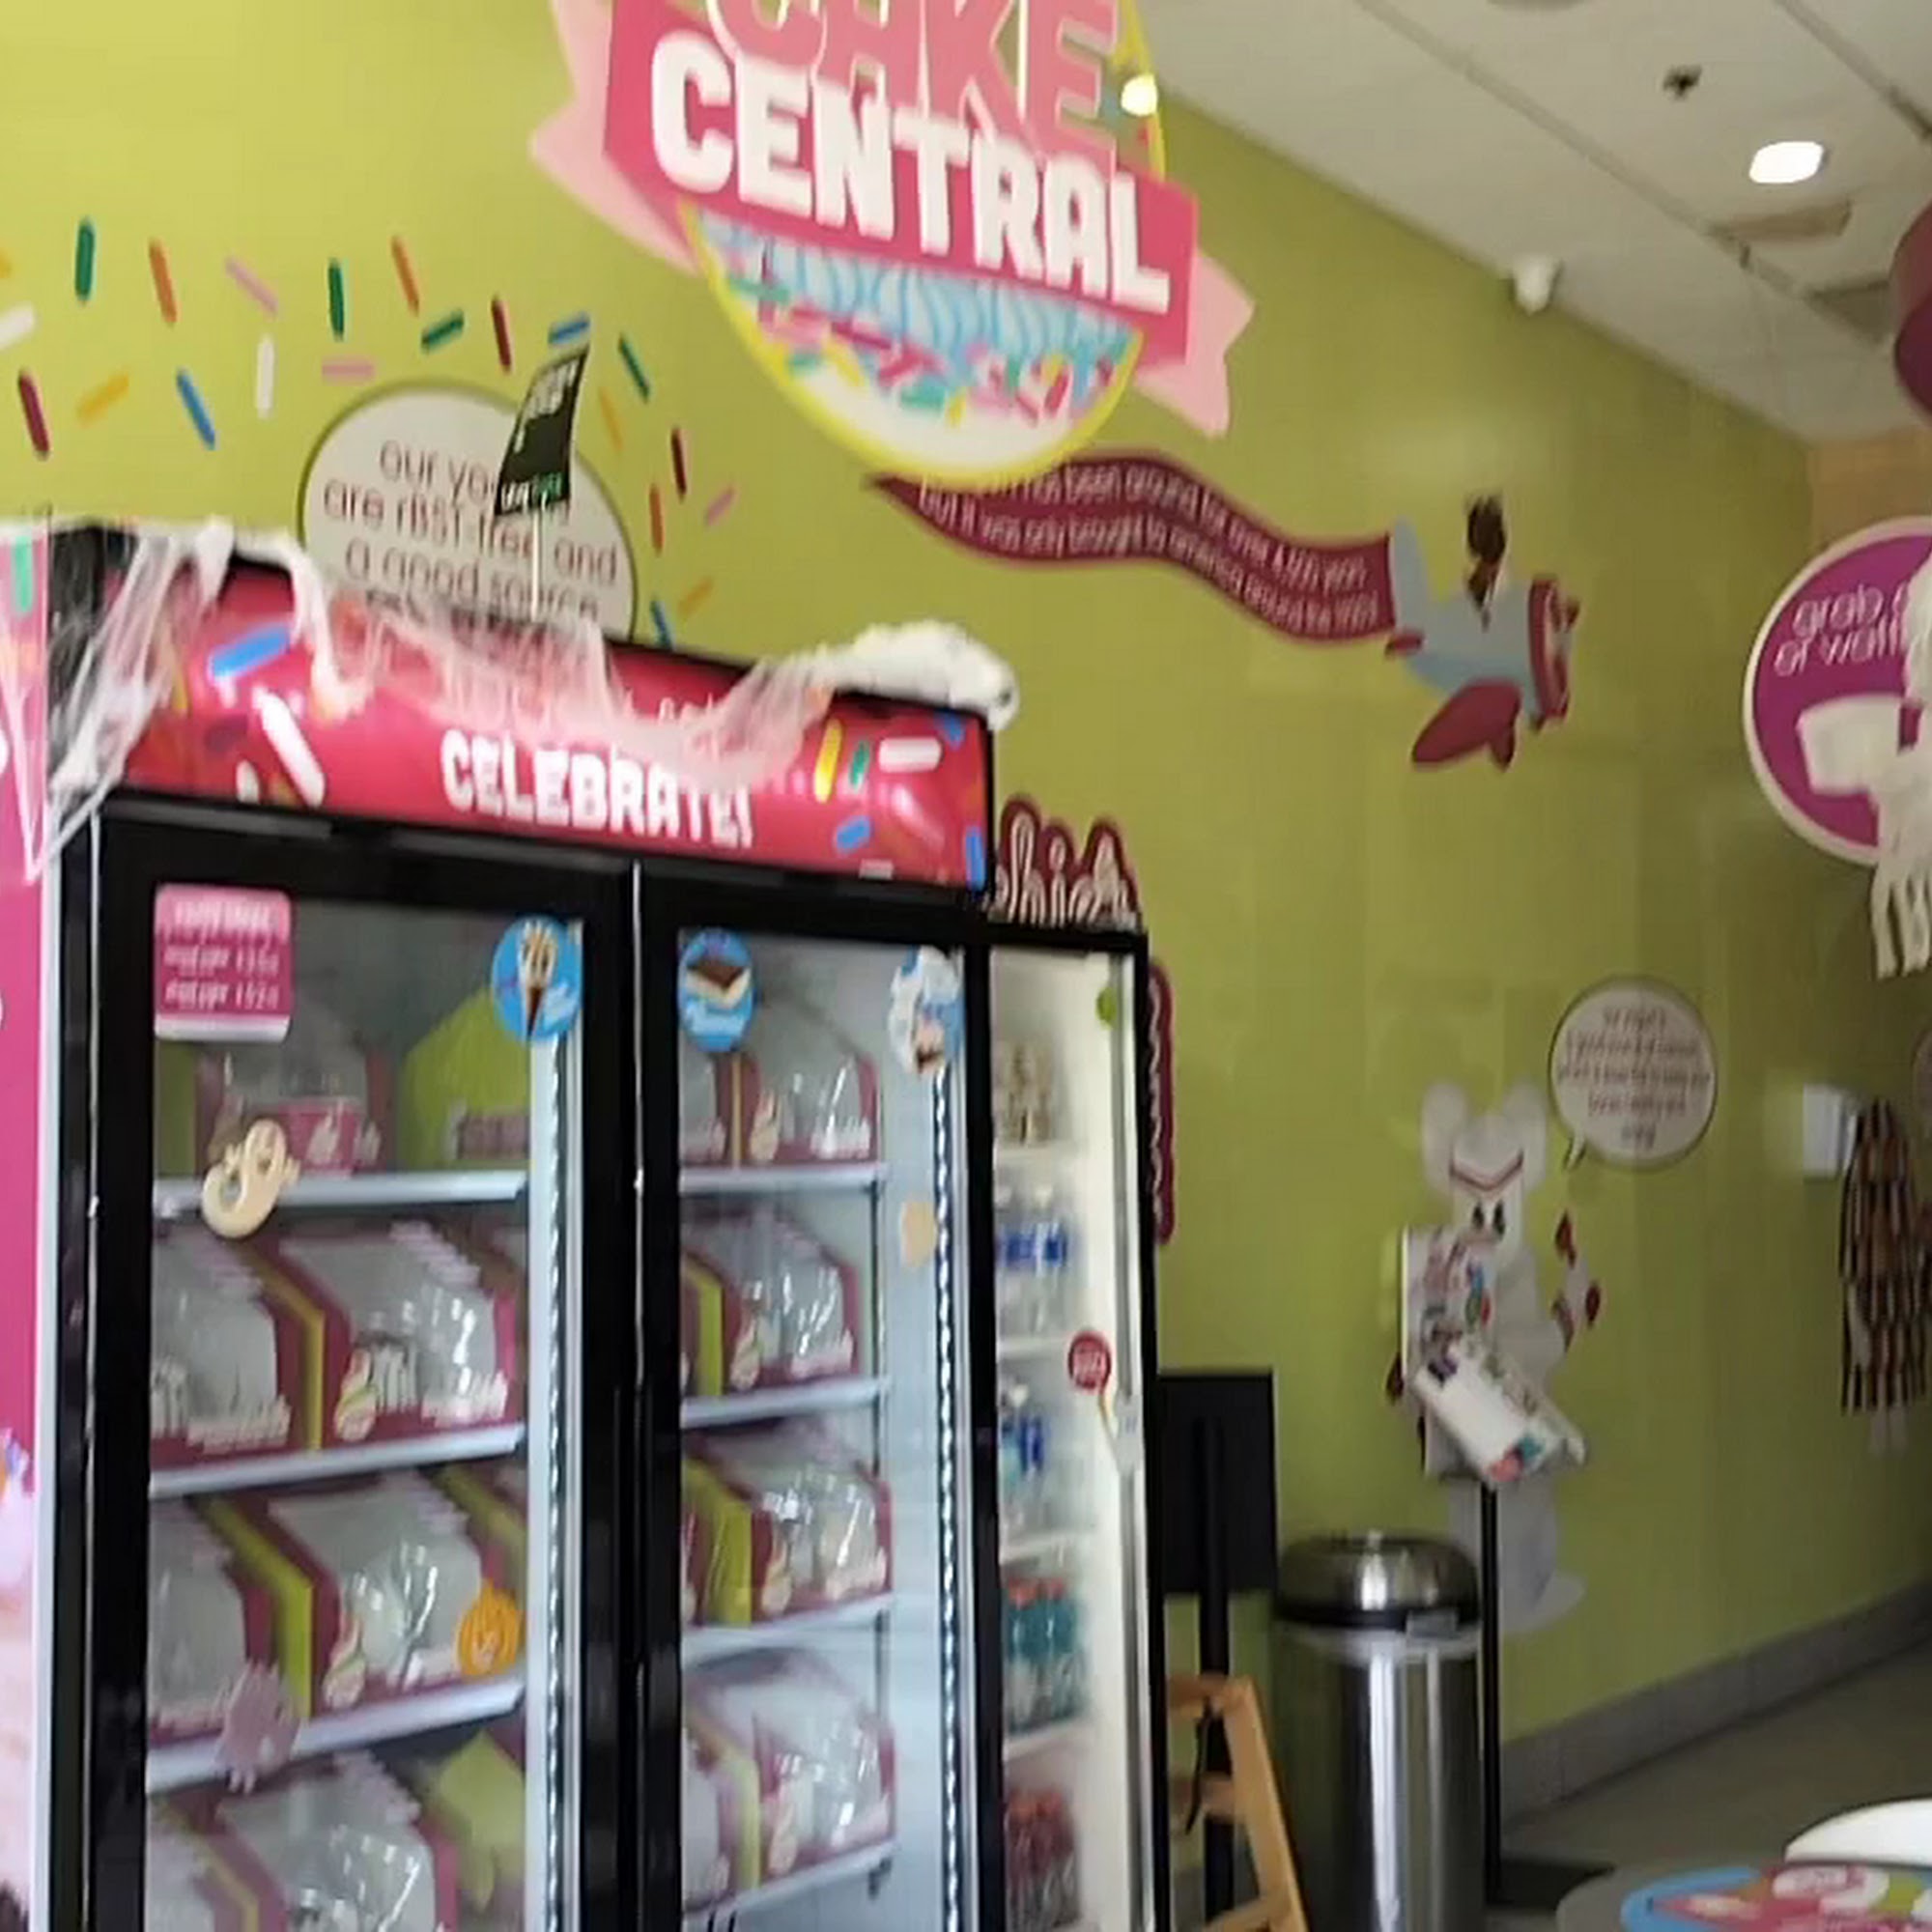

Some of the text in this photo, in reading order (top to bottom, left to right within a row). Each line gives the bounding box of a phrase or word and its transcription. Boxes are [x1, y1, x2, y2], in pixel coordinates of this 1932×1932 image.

[649, 29, 1171, 316] CENTRAL
[324, 477, 384, 530] are
[554, 535, 616, 587] and
[1792, 582, 1884, 645] grab
